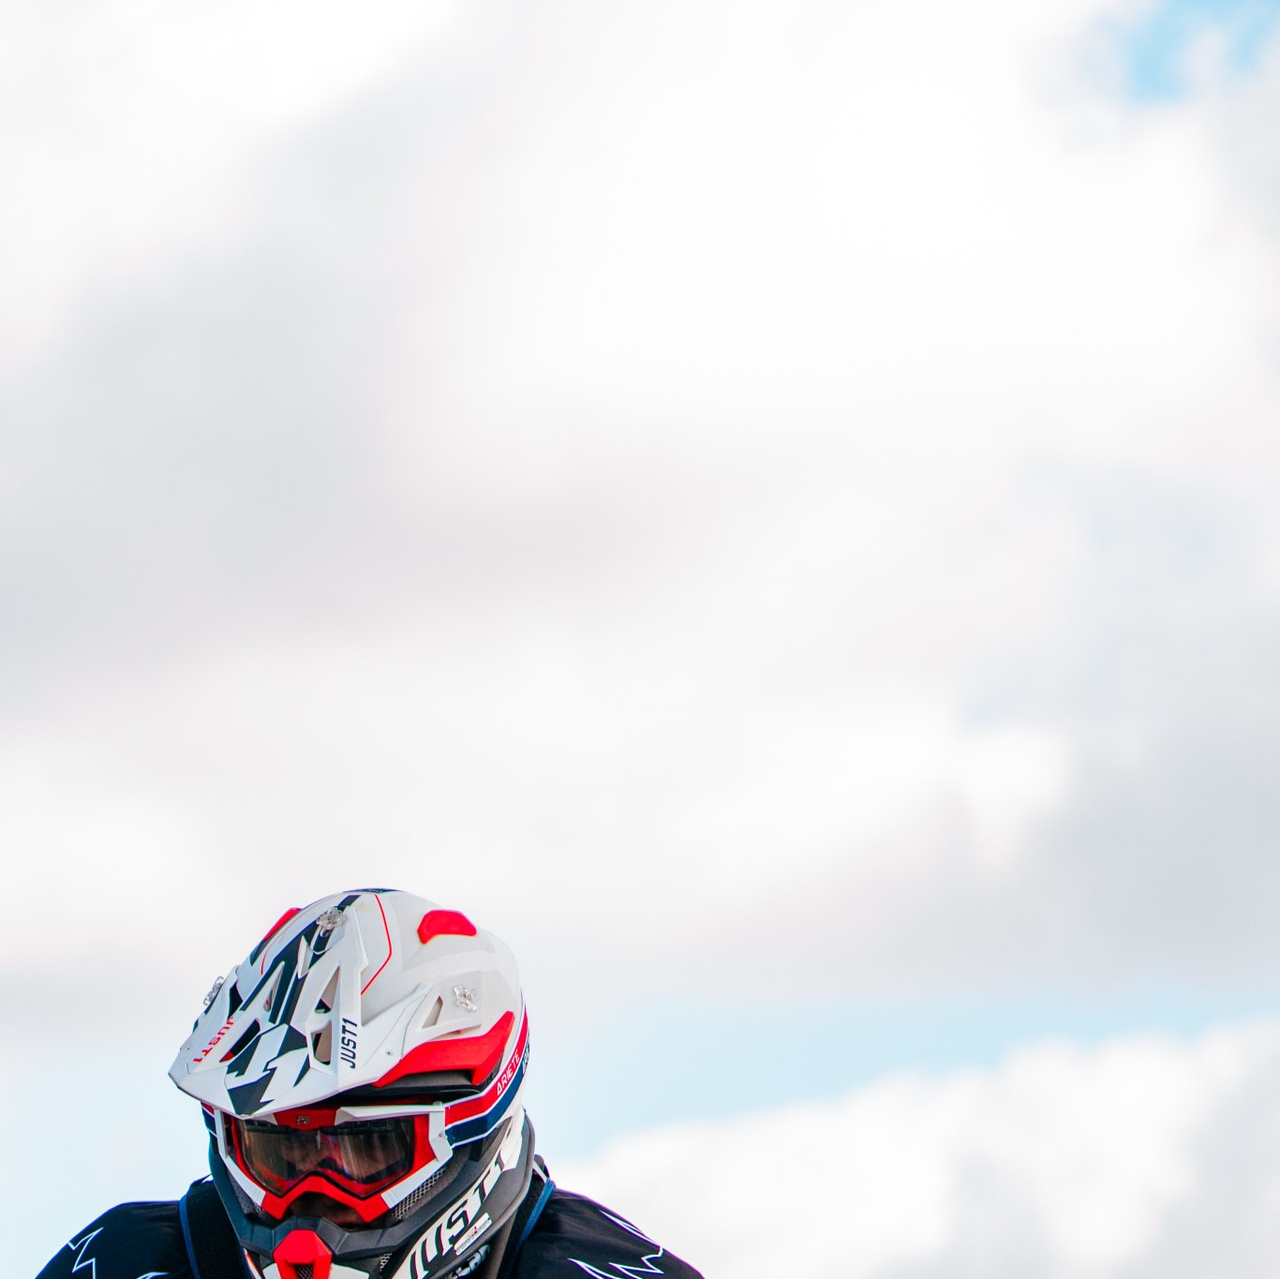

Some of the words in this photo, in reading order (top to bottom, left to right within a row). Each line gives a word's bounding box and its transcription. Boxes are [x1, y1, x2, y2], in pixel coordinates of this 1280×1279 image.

[193, 1015, 234, 1064] JUST1
[340, 1017, 358, 1069] JUST1
[496, 1049, 520, 1096] ARIETE
